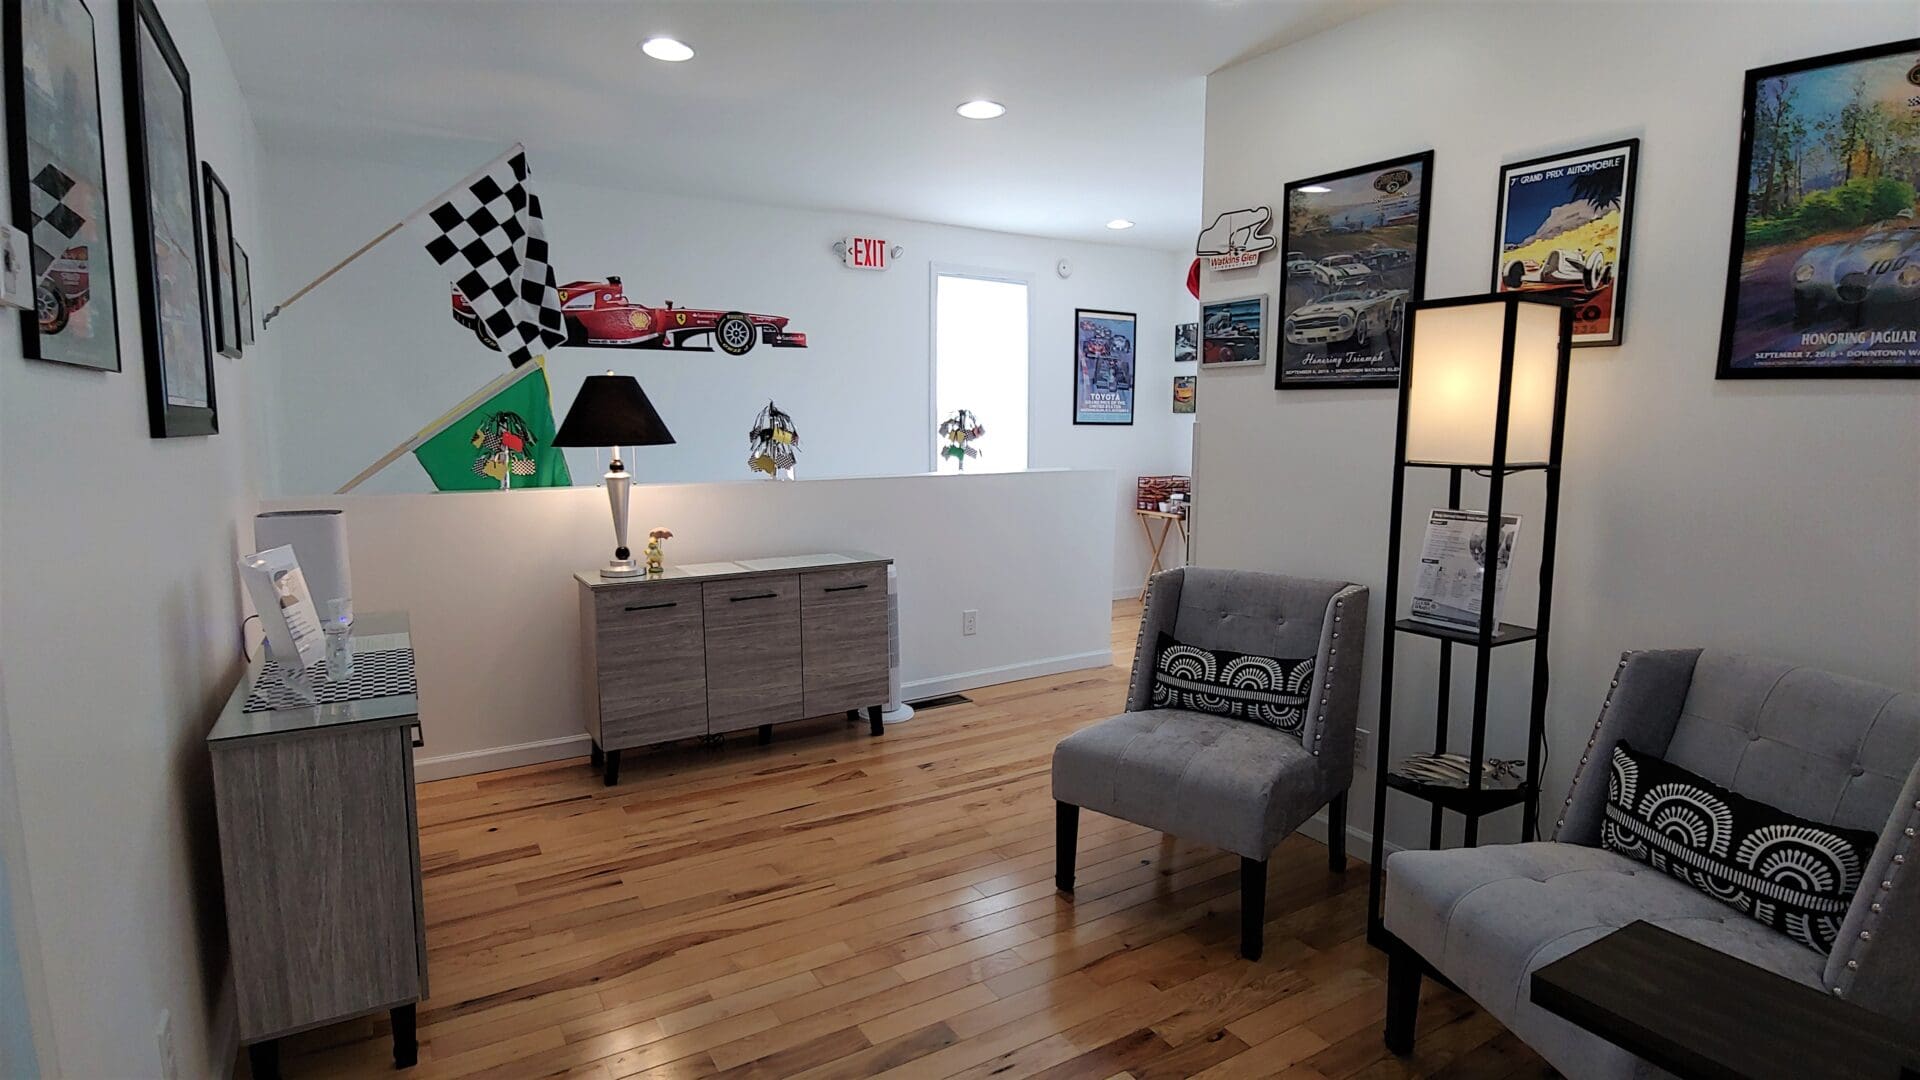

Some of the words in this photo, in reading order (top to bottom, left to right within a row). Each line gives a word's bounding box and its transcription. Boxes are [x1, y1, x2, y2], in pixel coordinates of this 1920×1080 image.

[1520, 173, 1543, 185] GRAND
[1545, 168, 1564, 180] PRIX
[1566, 157, 1621, 175] AUTOMOBILE
[854, 237, 886, 267] EXIT
[1211, 254, 1240, 266] Watkins
[1241, 253, 1257, 262] Glen
[1801, 332, 1867, 346] HONORING
[1870, 330, 1917, 346] JAGUAR
[1302, 353, 1342, 367] Honoring
[1345, 351, 1384, 364] Triumph
[1755, 351, 1803, 360] SEPTEMBER
[1847, 349, 1906, 358] DOWNTOWN
[1090, 393, 1120, 401] TOYOTA
